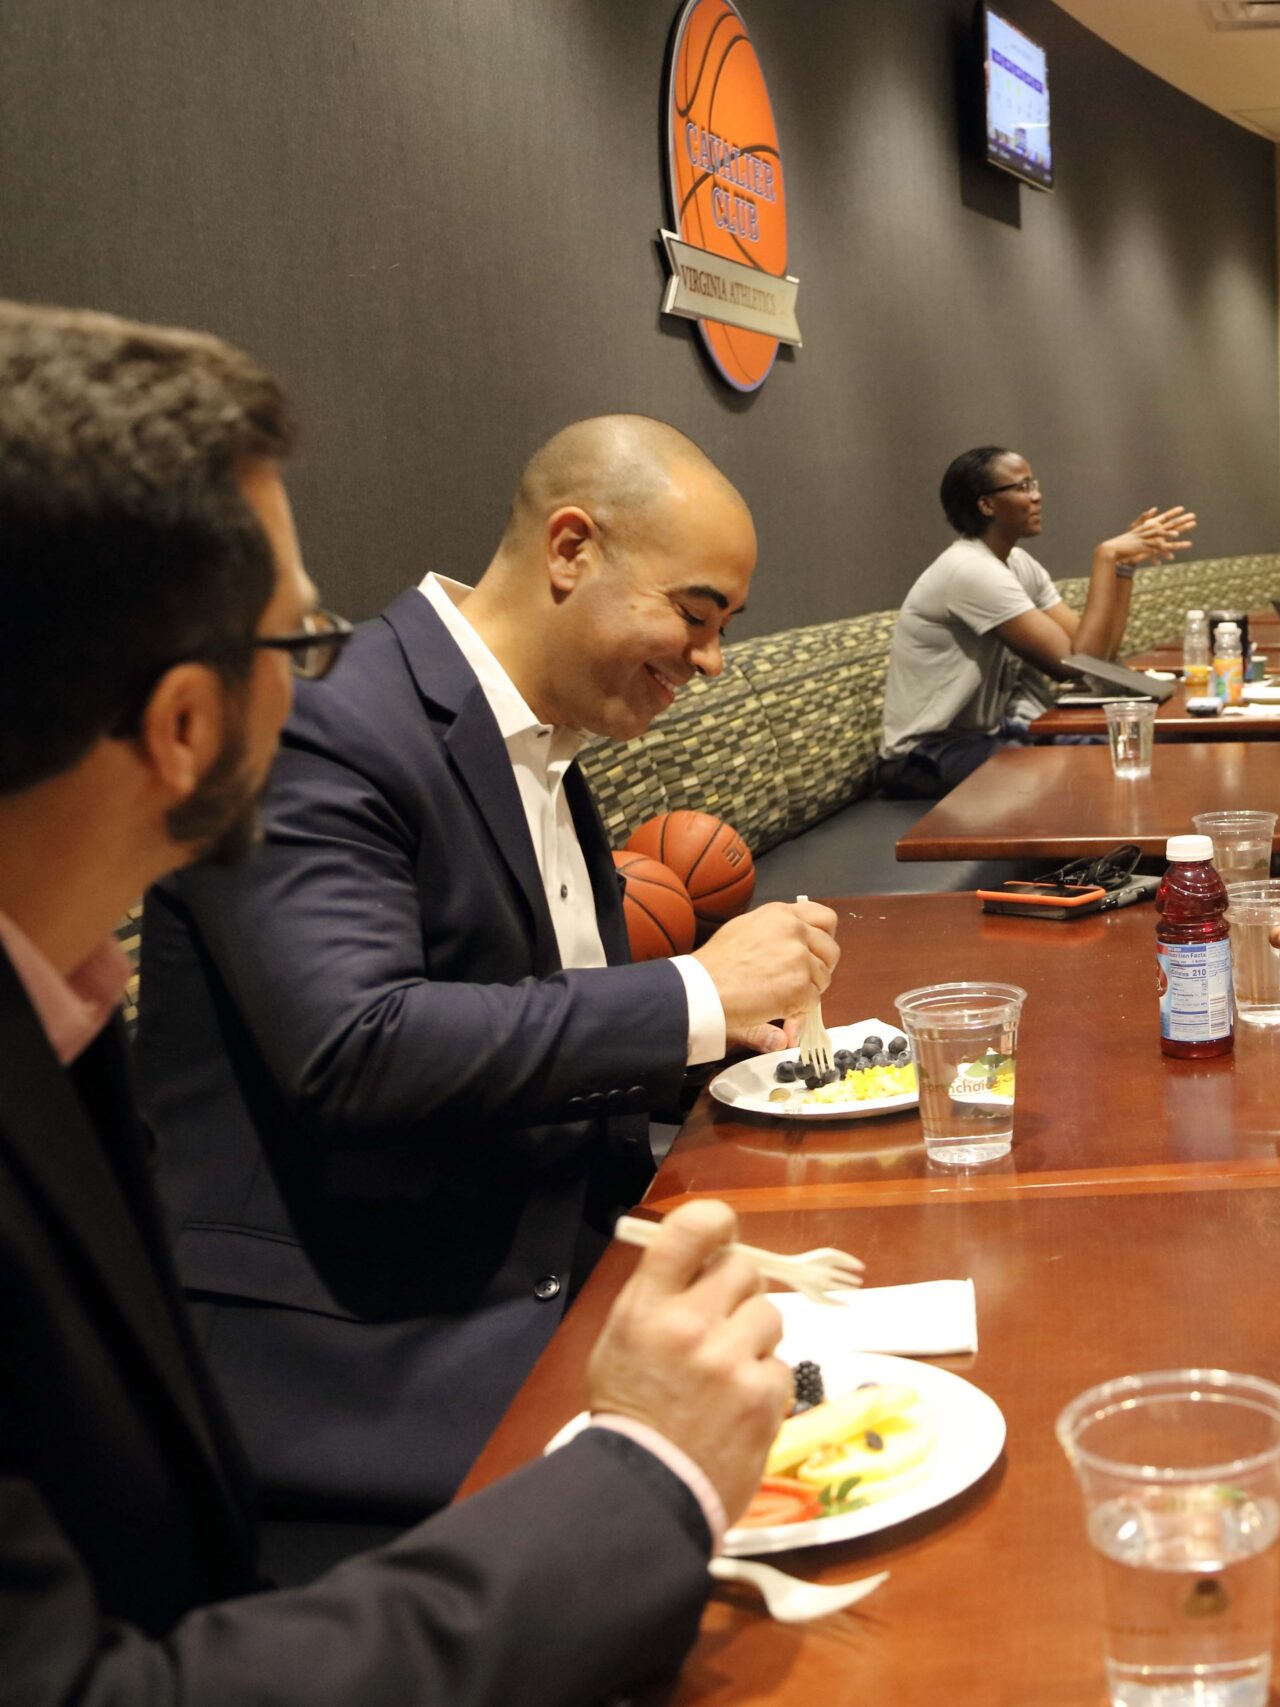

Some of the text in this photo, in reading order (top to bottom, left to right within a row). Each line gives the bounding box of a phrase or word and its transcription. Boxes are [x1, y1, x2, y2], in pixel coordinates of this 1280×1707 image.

[685, 121, 776, 204] CAVALIER
[712, 186, 759, 243] CLUB
[680, 264, 776, 317] VIRGINIA ATHLETICS
[1192, 968, 1207, 977] 210
